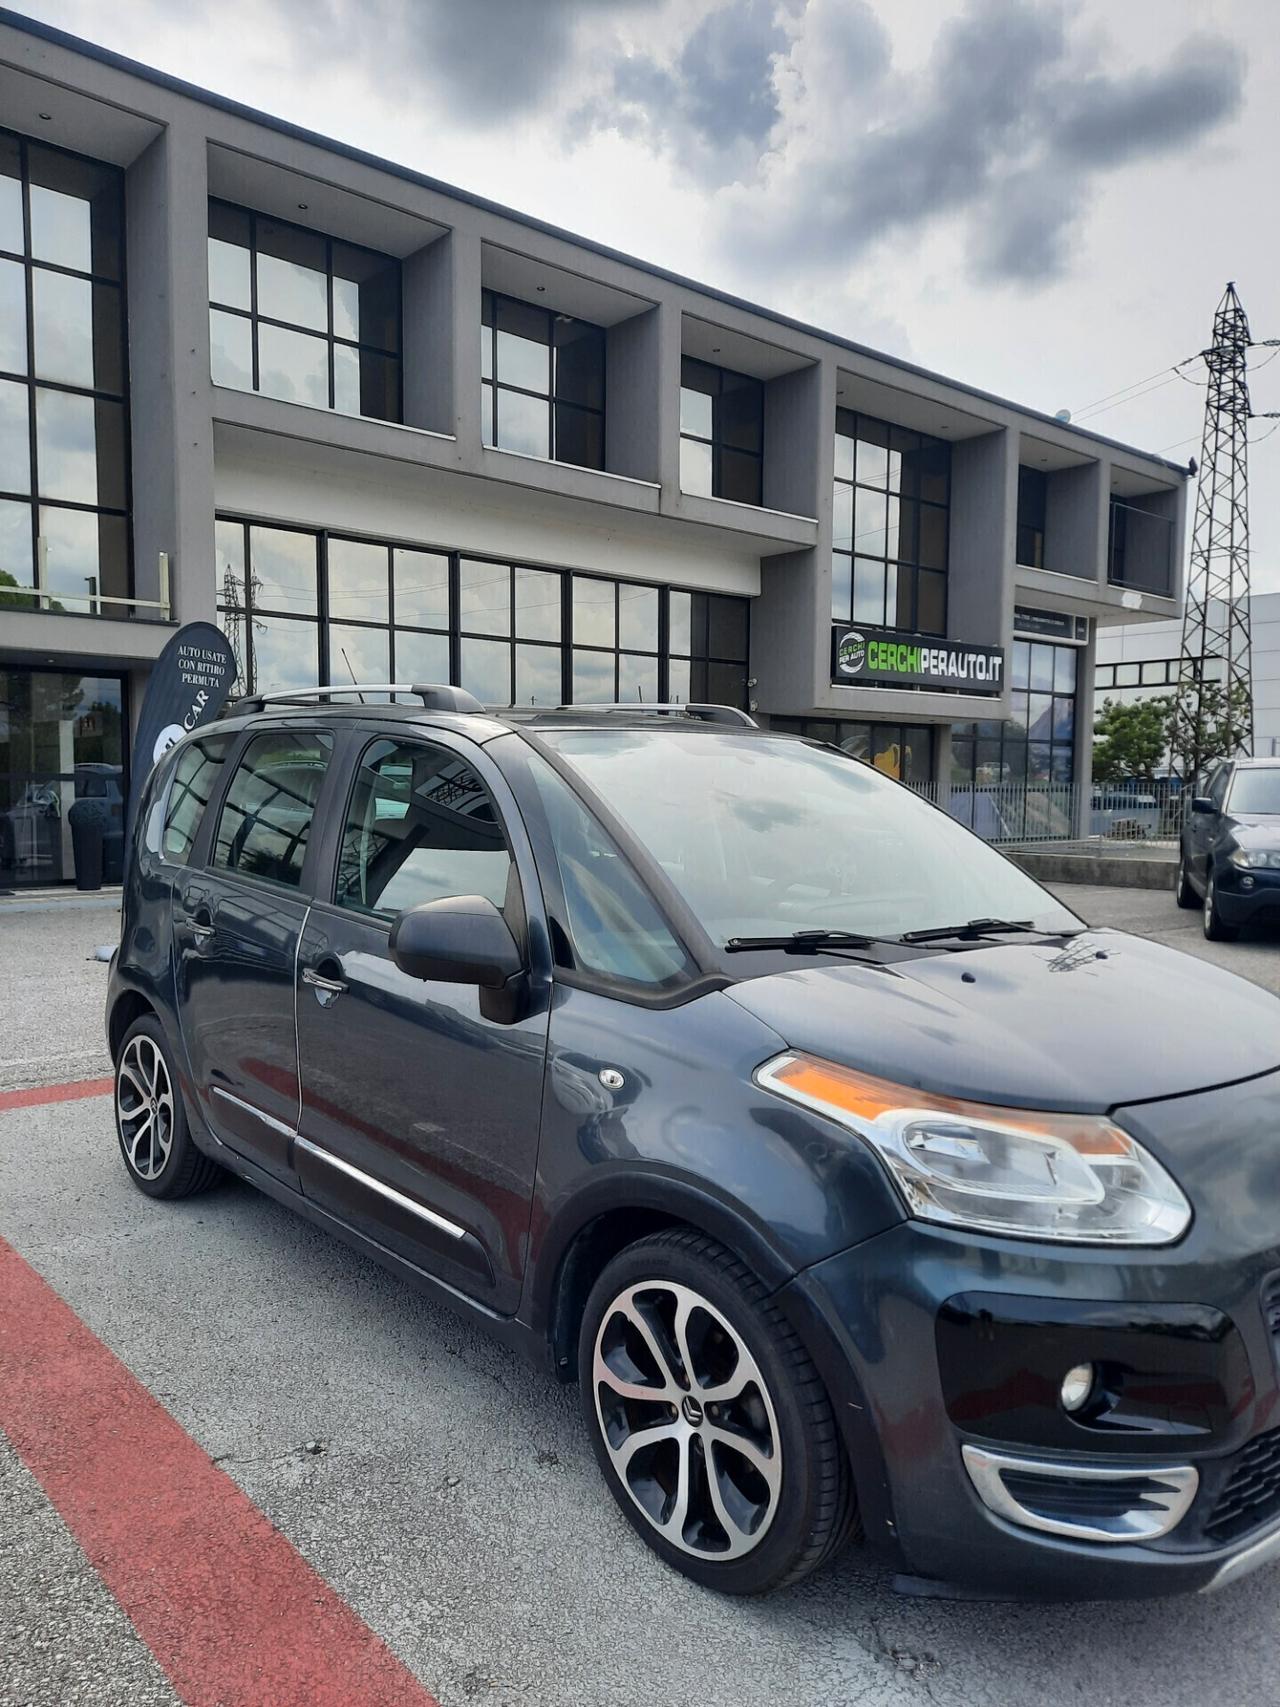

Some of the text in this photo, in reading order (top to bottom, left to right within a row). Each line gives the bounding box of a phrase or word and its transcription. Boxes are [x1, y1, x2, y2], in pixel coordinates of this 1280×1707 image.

[177, 645, 227, 664] AUTO USATE
[867, 640, 1002, 681] CERCHIPERAUTO.IT
[178, 658, 225, 675] CON RITIRO
[182, 672, 220, 688] PERMUTA
[184, 689, 209, 730] CAR
